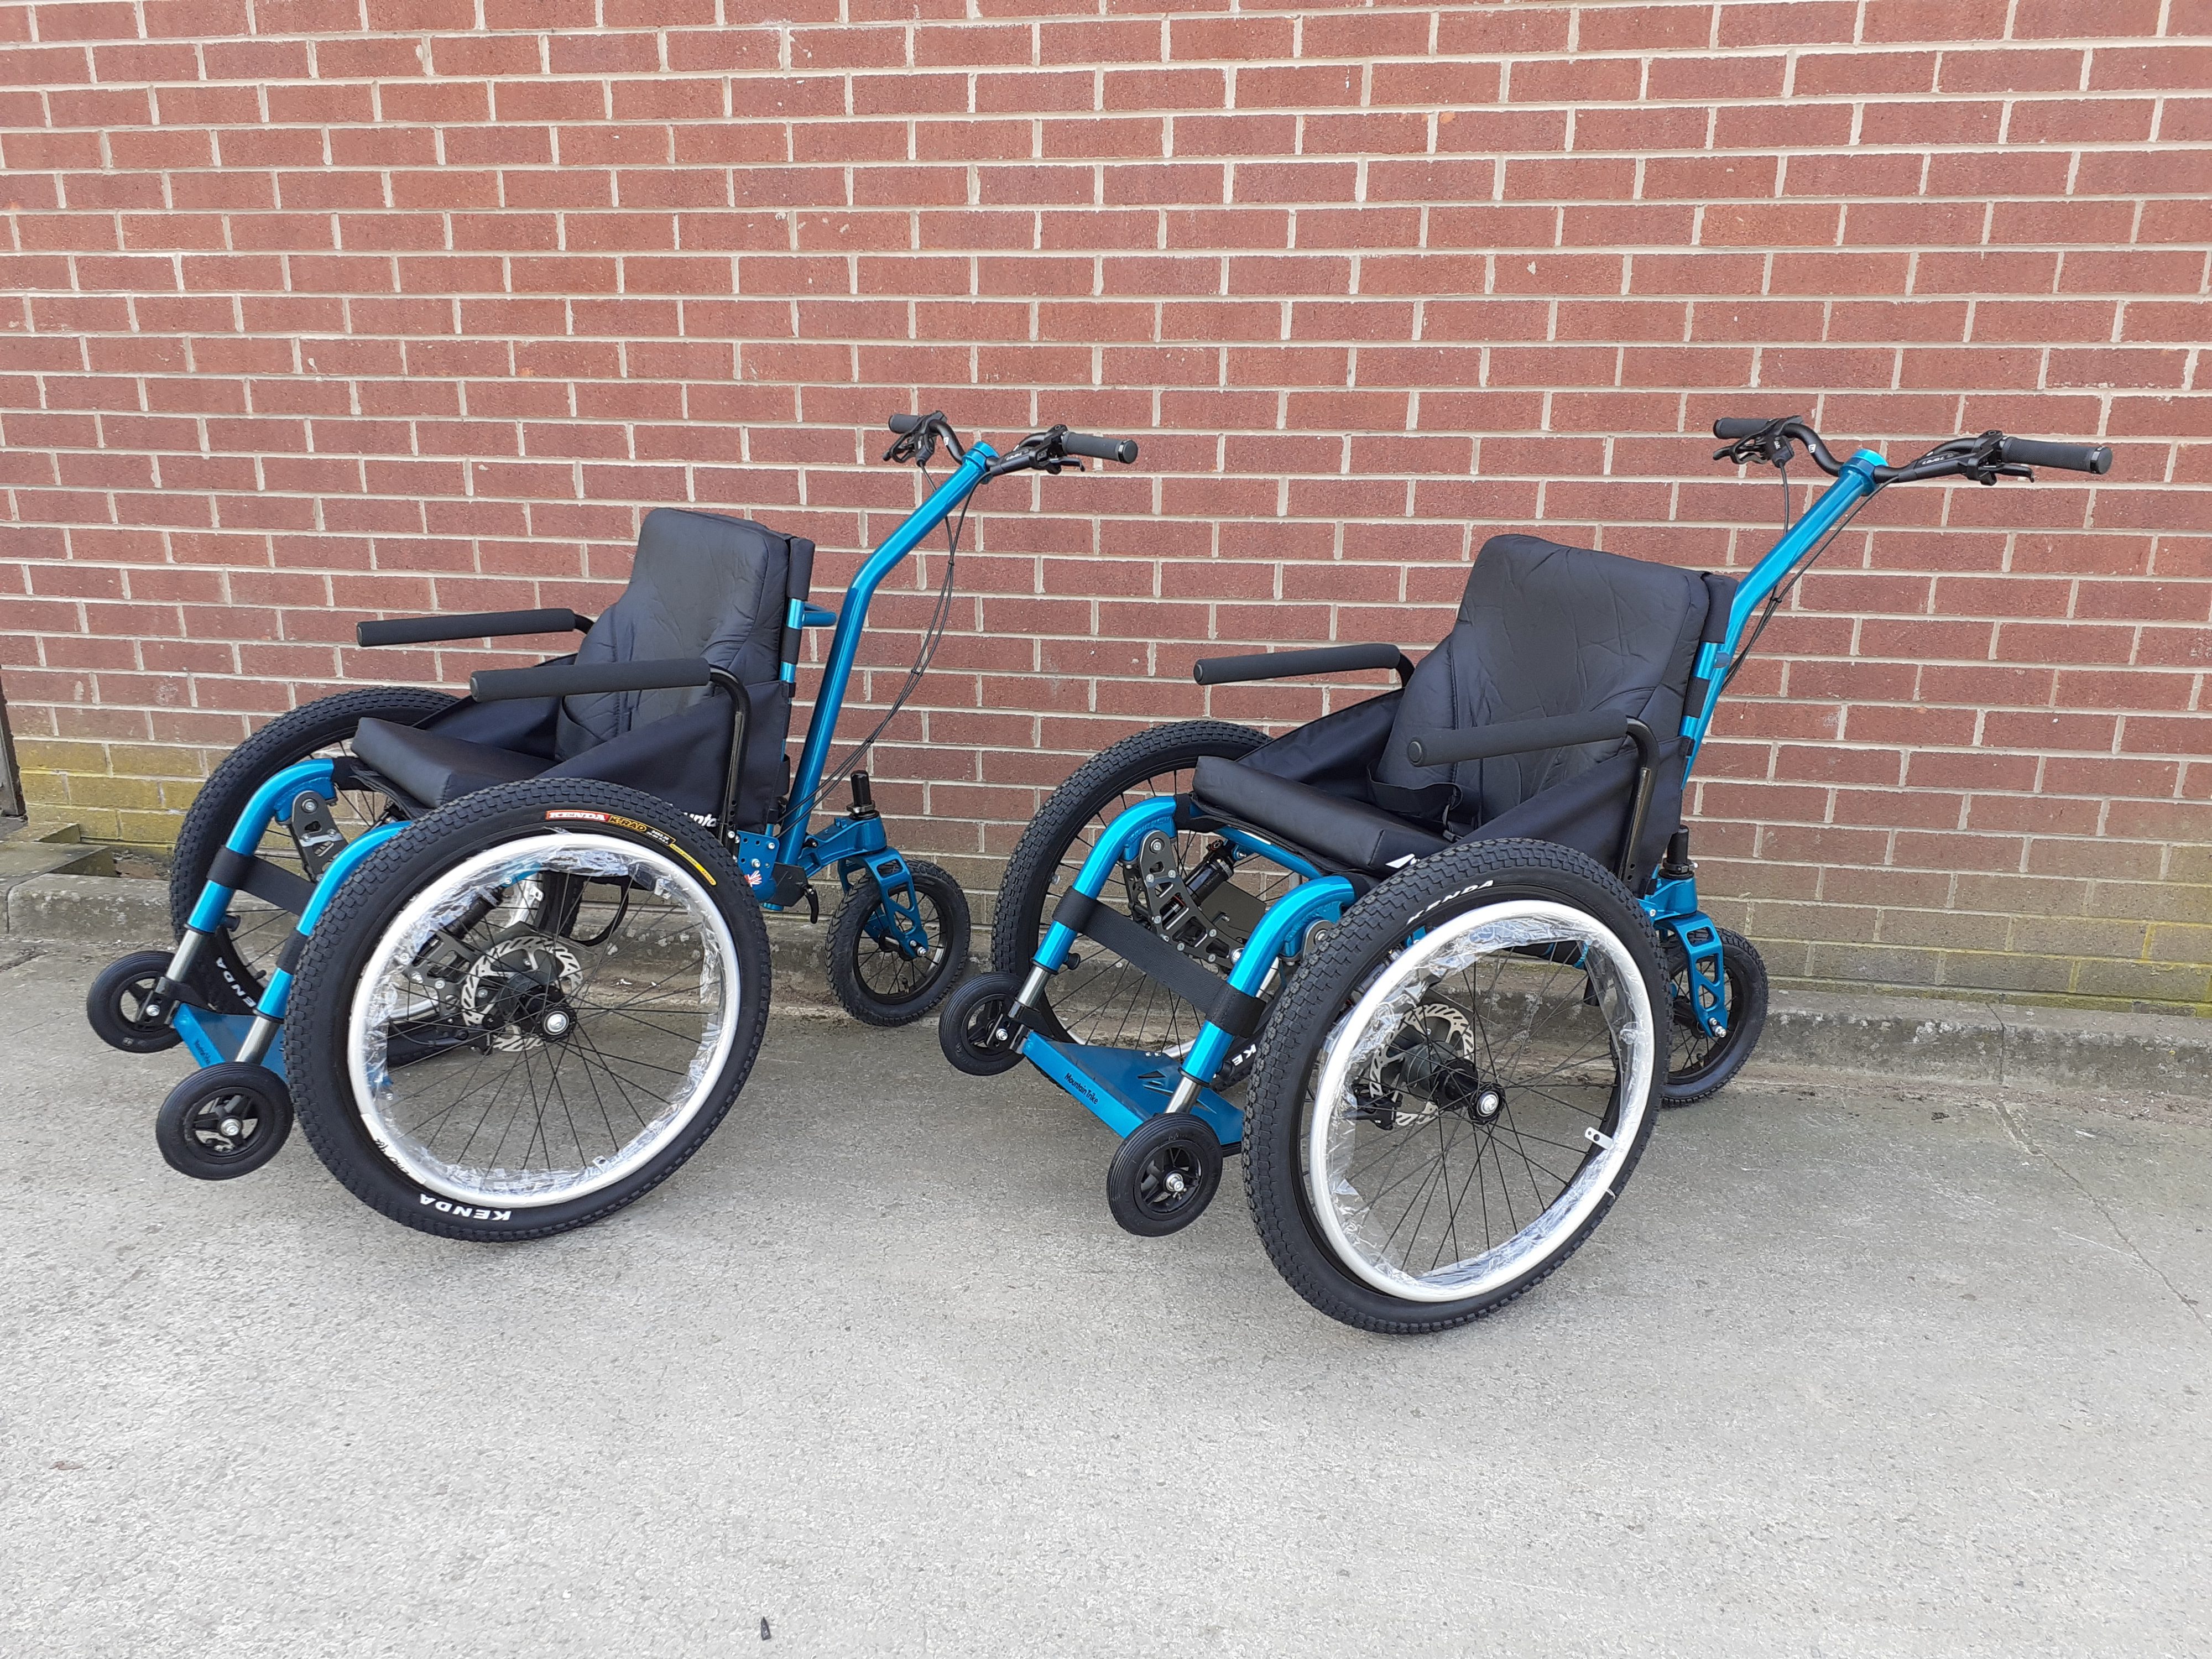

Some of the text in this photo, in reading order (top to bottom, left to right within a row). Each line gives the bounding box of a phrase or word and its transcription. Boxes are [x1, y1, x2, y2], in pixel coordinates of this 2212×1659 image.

[549, 811, 647, 832] KENDA K-RAD
[1406, 880, 1494, 925] KENDA
[216, 957, 257, 1008] ENDA
[1064, 1072, 1099, 1104] Mountain Trike
[419, 1193, 512, 1220] KENDA
